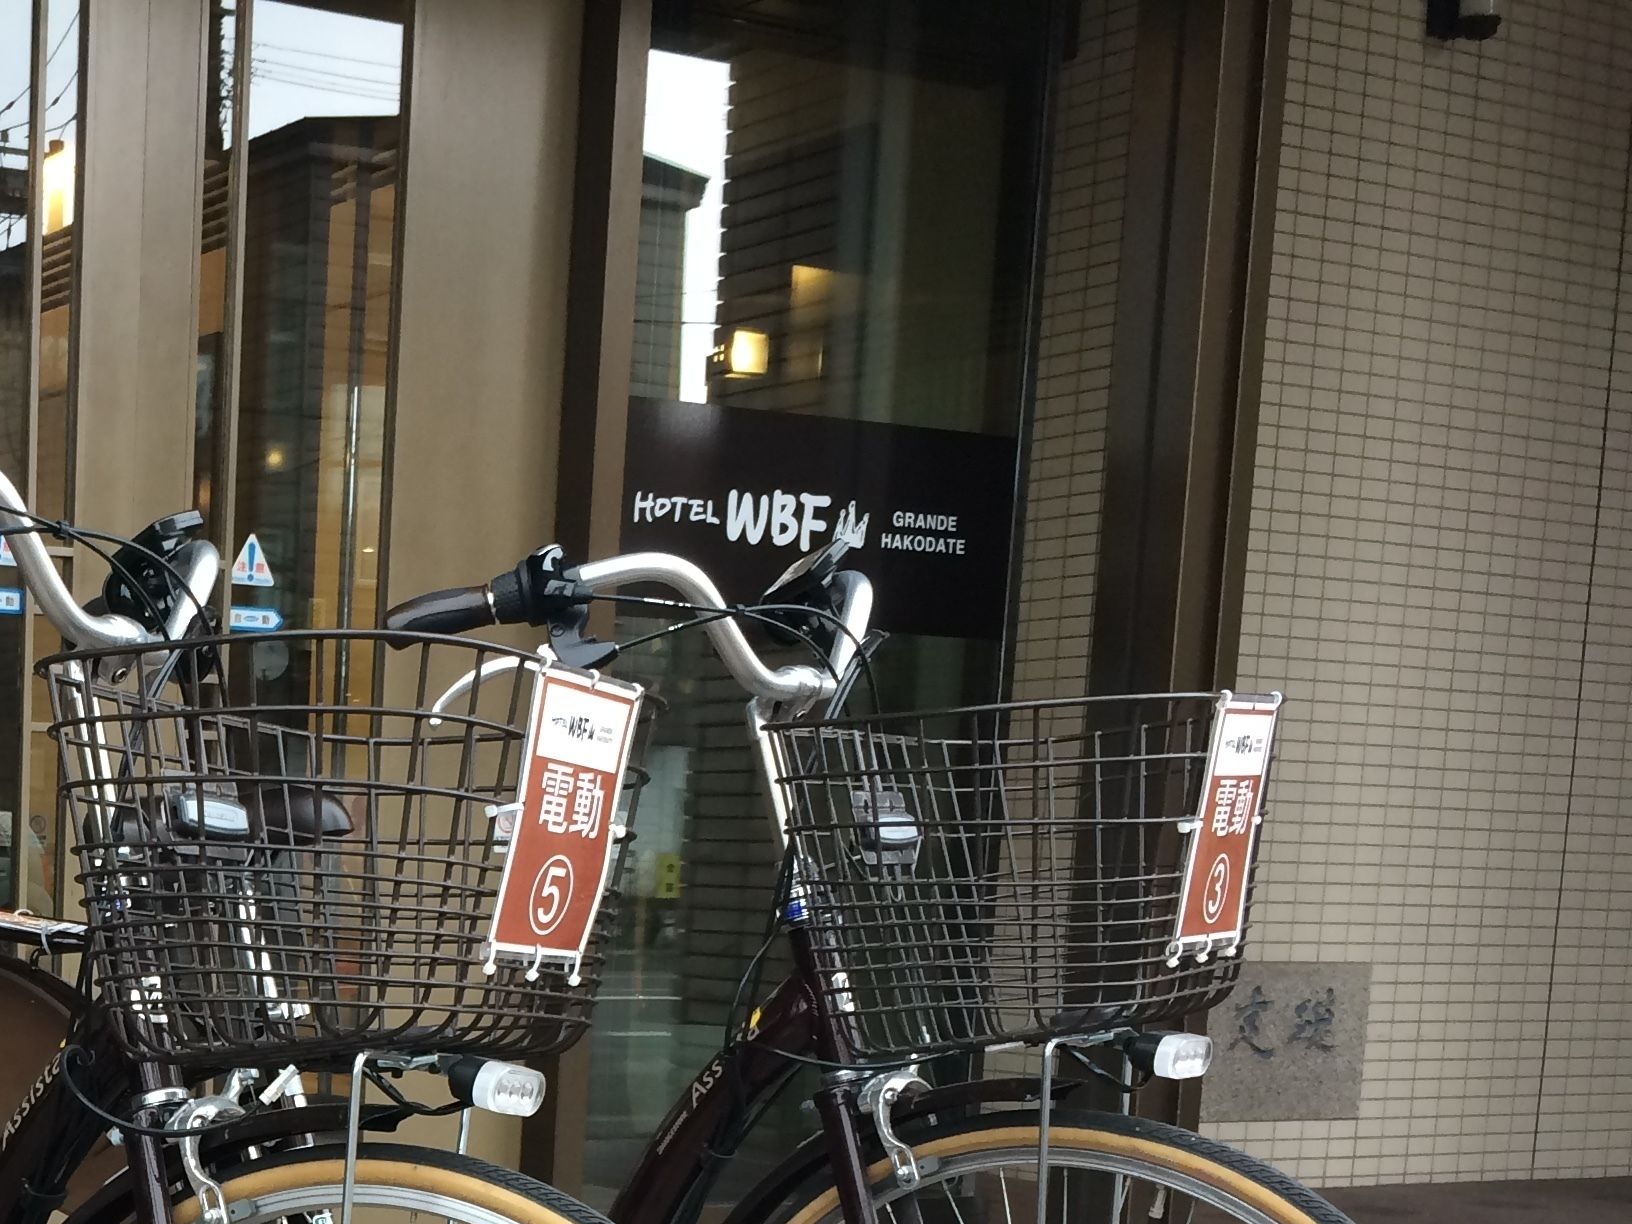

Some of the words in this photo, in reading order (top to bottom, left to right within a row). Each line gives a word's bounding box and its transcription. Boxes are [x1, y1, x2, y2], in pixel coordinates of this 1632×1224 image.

[633, 491, 720, 525] HOTEL
[726, 489, 832, 552] WBF
[881, 533, 966, 555] HAKODATE
[892, 510, 958, 532] GRANDE
[538, 762, 604, 839] 電動
[1211, 778, 1254, 837] 電動
